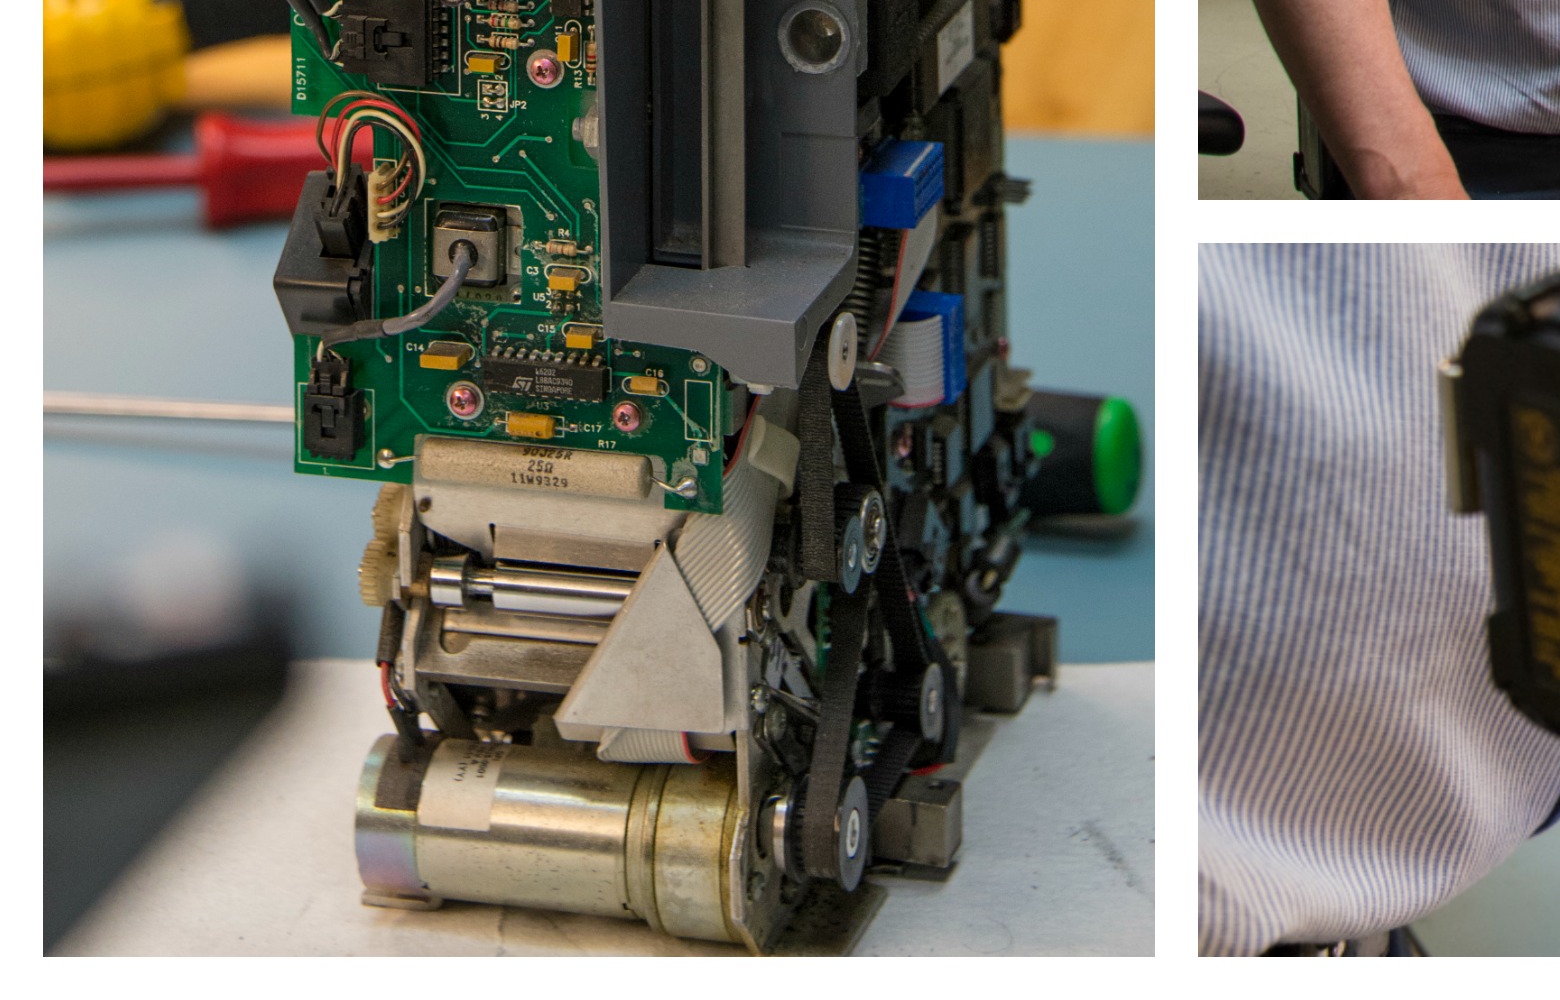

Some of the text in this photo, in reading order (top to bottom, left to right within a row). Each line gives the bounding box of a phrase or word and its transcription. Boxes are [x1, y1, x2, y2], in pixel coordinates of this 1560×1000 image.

[296, 57, 307, 100] D15711
[574, 70, 583, 89] R13
[509, 100, 527, 110] JP2
[558, 228, 570, 238] R4
[526, 266, 540, 276] C3
[533, 292, 546, 302] U5
[537, 324, 556, 334] C15
[405, 342, 425, 352] C14
[645, 368, 665, 378] C16
[583, 424, 602, 433] C17
[598, 440, 616, 449] R17
[510, 471, 568, 488] 11W9329
